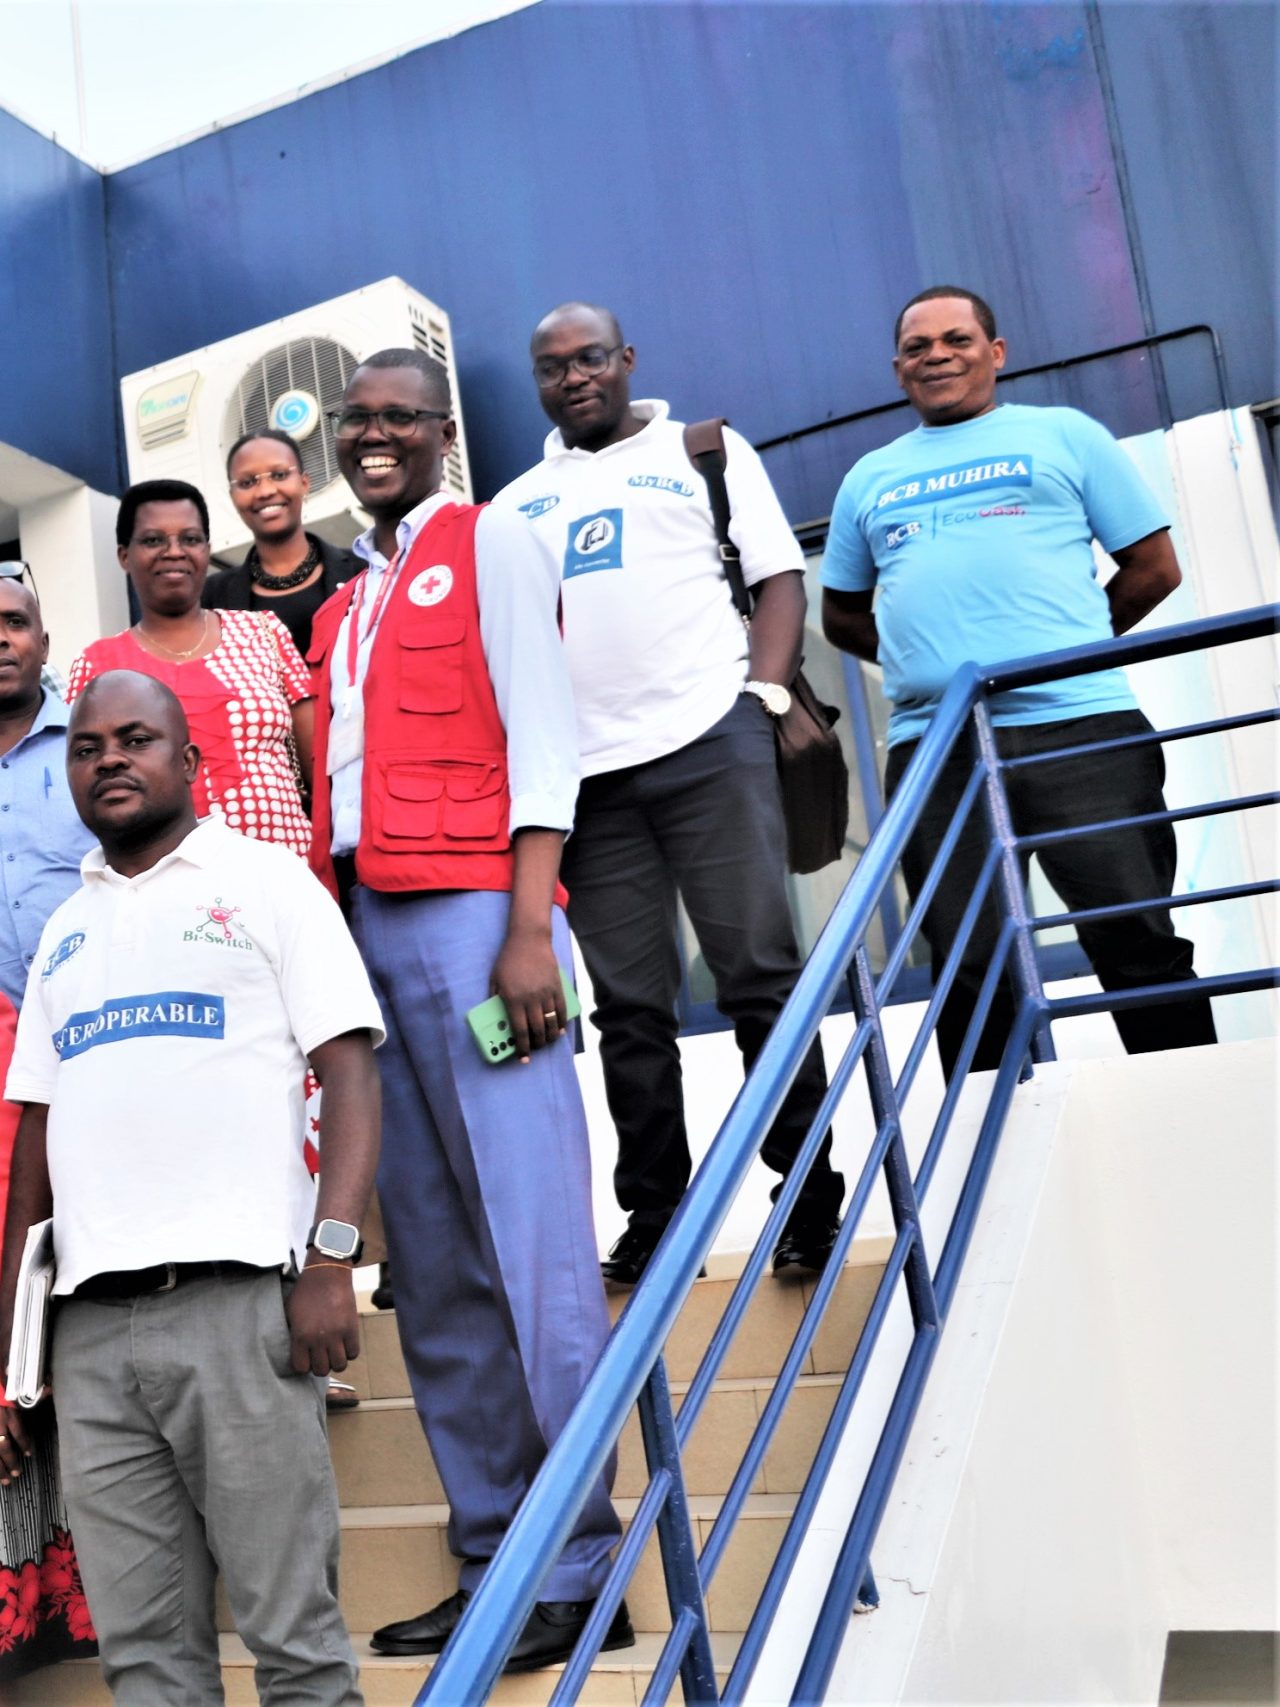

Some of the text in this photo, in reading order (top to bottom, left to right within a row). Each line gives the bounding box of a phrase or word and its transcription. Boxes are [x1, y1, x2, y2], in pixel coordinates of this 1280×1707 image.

[878, 460, 1029, 509] BCB MUHIRA
[886, 520, 921, 548] BCB
[183, 930, 253, 951] Bi-Switch
